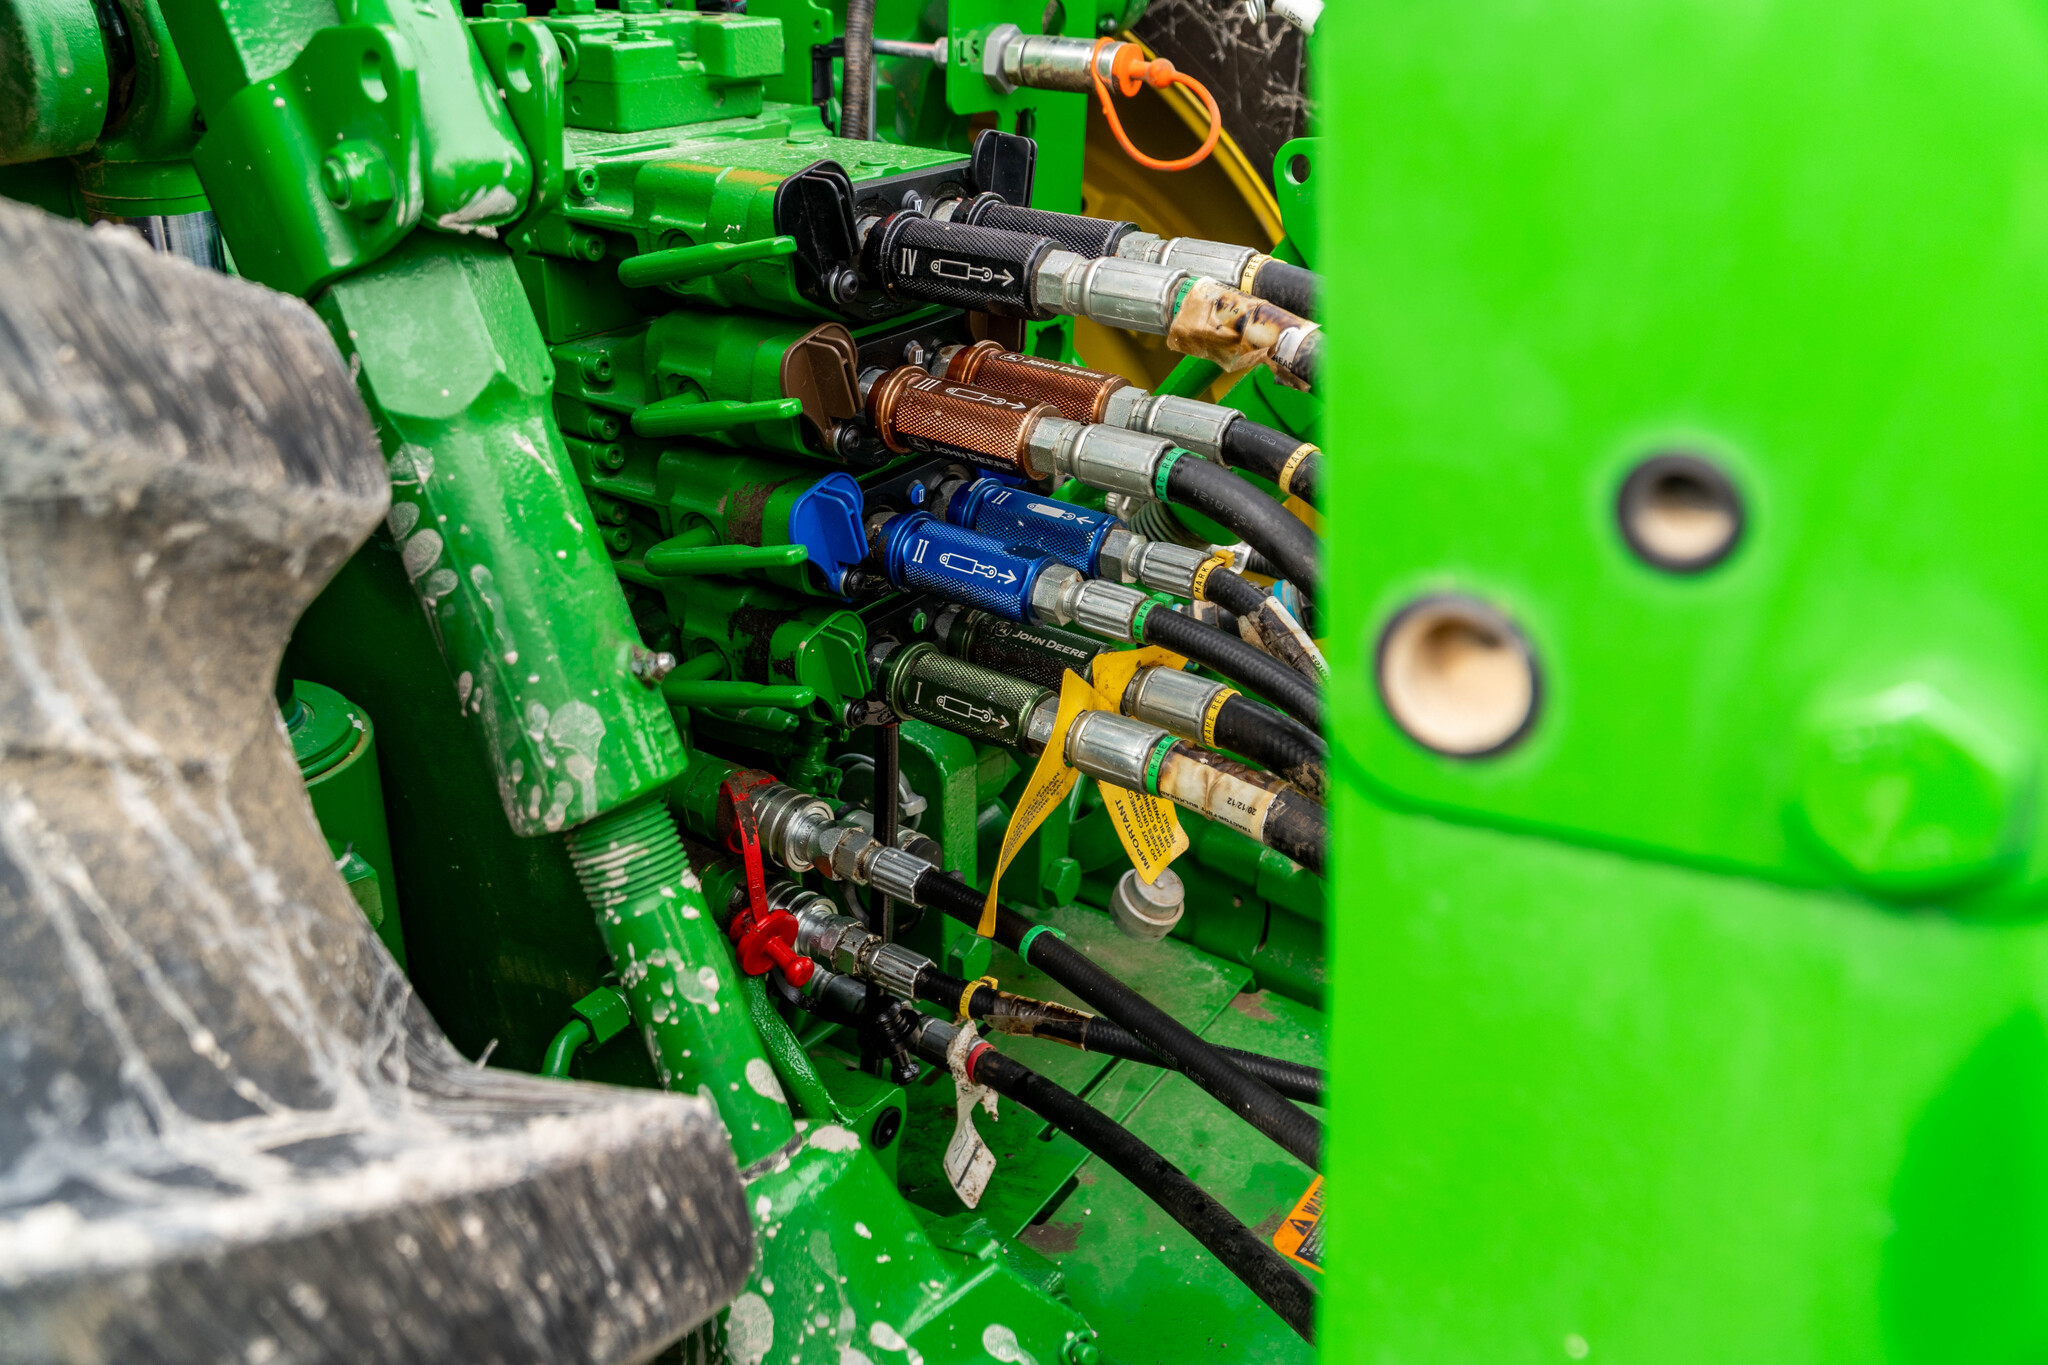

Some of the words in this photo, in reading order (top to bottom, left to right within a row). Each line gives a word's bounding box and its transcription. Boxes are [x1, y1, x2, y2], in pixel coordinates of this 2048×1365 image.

[900, 247, 918, 276] IV
[1023, 359, 1057, 370] JOHN
[1059, 365, 1104, 379] DEERE
[913, 378, 941, 391] III
[933, 444, 968, 459] JOHN
[967, 453, 1013, 470] DEERE
[991, 491, 1012, 504] II
[912, 539, 930, 564] II
[1195, 566, 1209, 593] MARK
[1012, 629, 1045, 646] JOHN
[1045, 640, 1088, 659] DEERE
[914, 681, 922, 704] I
[1149, 743, 1167, 777] FRAME
[1139, 802, 1150, 827] UNTIL
[1151, 799, 1166, 834] BLOWER
[1226, 797, 1258, 816] 20/12/12
[1114, 799, 1151, 870] IMPORTANT
[1141, 830, 1152, 847] NOT
[1152, 824, 1158, 832] IS
[1147, 828, 1163, 857] HOSES
[1156, 834, 1167, 852] LINE
[1164, 835, 1171, 848] OR
[1150, 848, 1158, 861] DO
